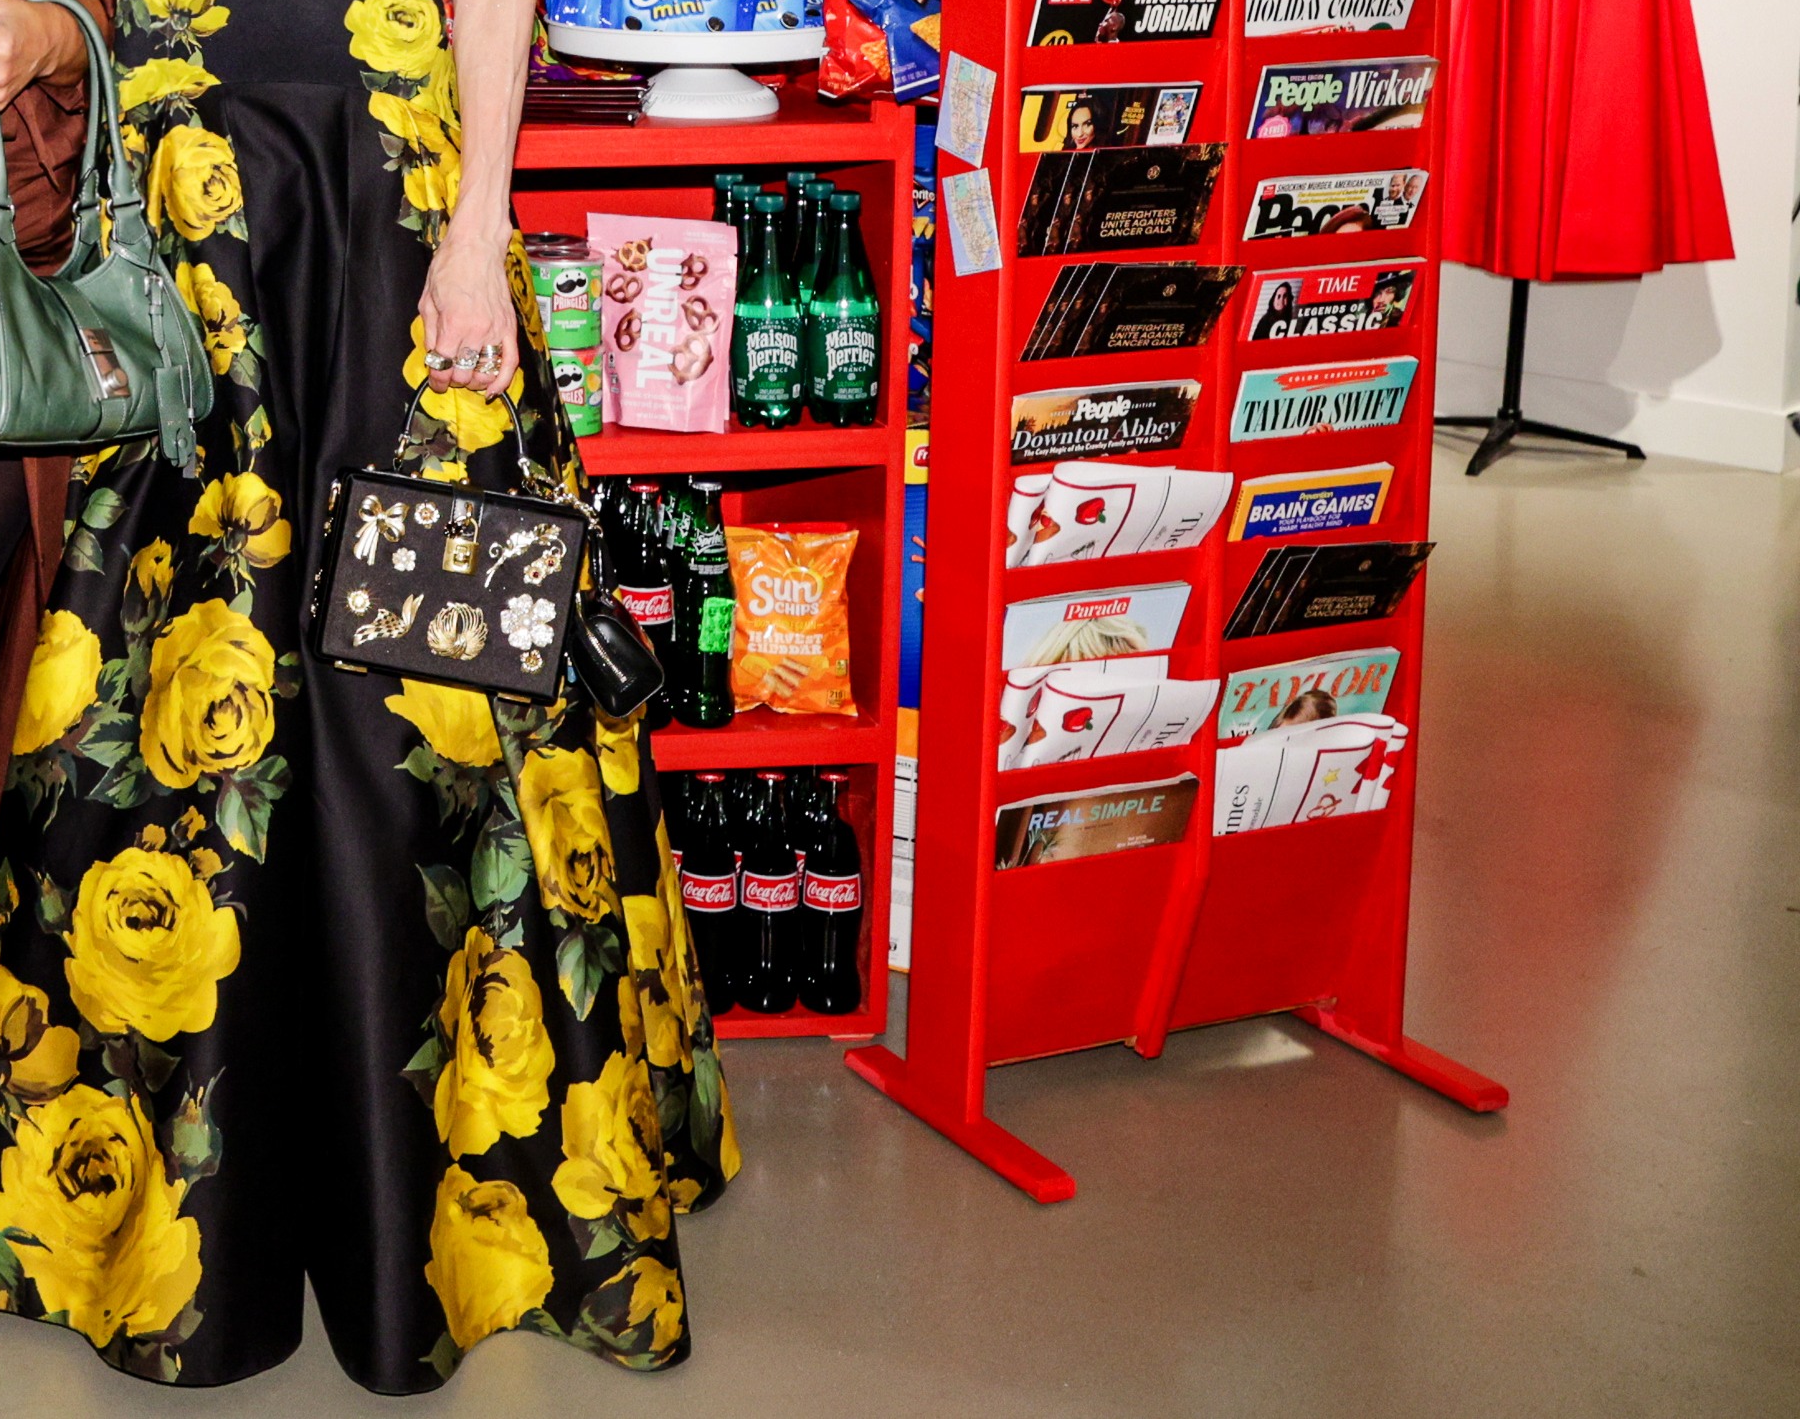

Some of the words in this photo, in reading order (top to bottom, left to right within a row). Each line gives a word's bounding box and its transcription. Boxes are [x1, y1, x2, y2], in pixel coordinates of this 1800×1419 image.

[1134, 3, 1215, 34] JORDAN
[1264, 73, 1344, 113] People
[1345, 66, 1432, 110] Wicked
[1100, 218, 1132, 230] UNITE
[1132, 216, 1178, 228] AGAINST
[1105, 208, 1177, 221] FIREFIGHTERS
[1099, 226, 1142, 238] CANCER
[1144, 225, 1173, 235] GALA
[1317, 275, 1362, 294] TIME
[553, 294, 589, 312] PRINGLES
[1297, 304, 1347, 318] LEGENDS
[1349, 302, 1366, 313] OF
[635, 247, 688, 390] UNREAL
[1115, 322, 1186, 332] FIREFIGHTERS
[1268, 311, 1384, 340] CLASSIC
[746, 328, 798, 352] Maison
[825, 327, 875, 351] Maison
[1107, 338, 1149, 348] CANCER
[1151, 338, 1179, 346] GALA
[1109, 331, 1140, 340] UNITE
[1140, 330, 1186, 340] AGAINST
[759, 366, 788, 374] FRANCE
[1288, 374, 1319, 383] COLOR
[1323, 369, 1377, 380] CREATIVES
[1242, 393, 1328, 434] TAYLOR
[1328, 385, 1406, 424] SWIFT
[1011, 428, 1109, 452] Downton
[1112, 416, 1182, 441] Abbey
[1023, 449, 1034, 457] The
[1034, 447, 1050, 458] Cozy
[1049, 444, 1068, 456] Magic
[1074, 443, 1085, 452] the
[1085, 441, 1108, 452] Crawley
[1107, 439, 1127, 450] Family
[1149, 436, 1163, 445] Film
[1248, 499, 1309, 523] BRAIN
[1311, 493, 1376, 516] GAMES
[749, 573, 824, 617] Sun
[774, 600, 820, 617] CHIPS
[1066, 598, 1129, 620] Parade
[747, 641, 823, 656] CHEDDAR
[1232, 662, 1390, 714] TAYLOR
[1028, 807, 1085, 832] REAL
[1088, 794, 1167, 822] SIMPLE
[682, 880, 734, 903] Coca-Cola
[746, 880, 797, 903] Coca-Cola
[806, 880, 858, 903] Coca-Cola
